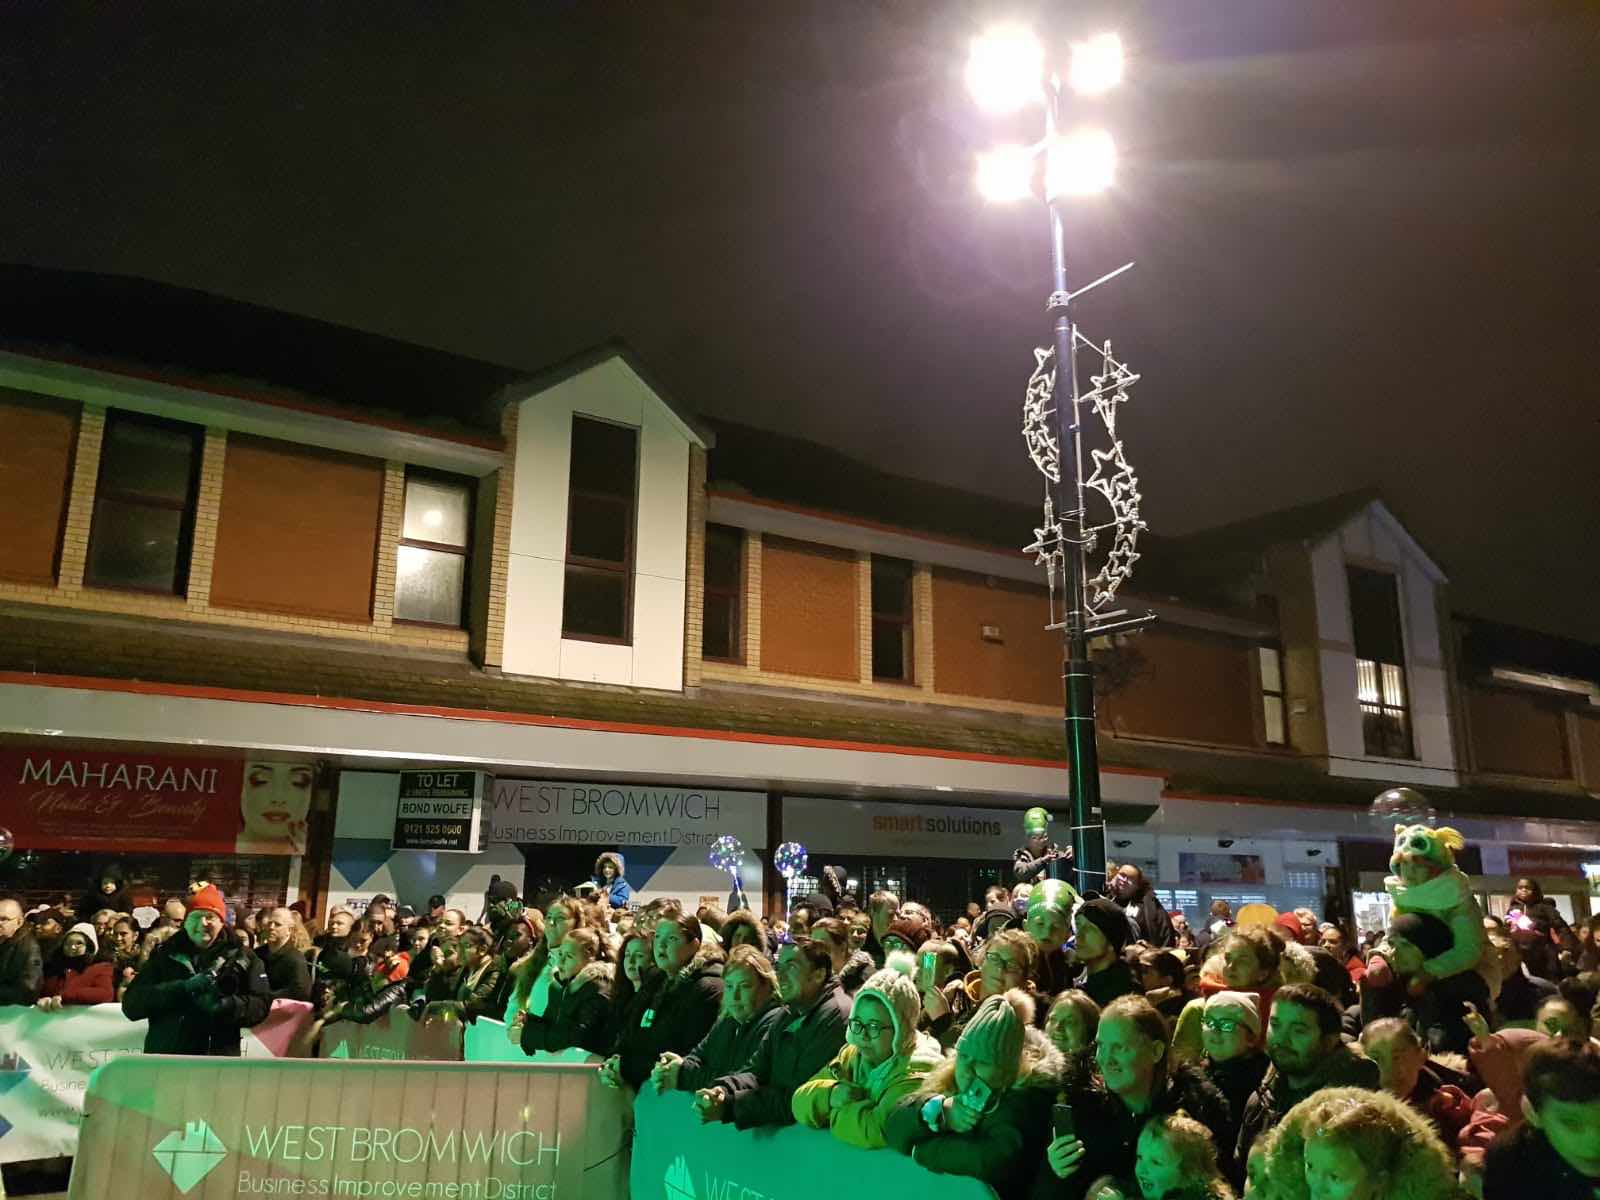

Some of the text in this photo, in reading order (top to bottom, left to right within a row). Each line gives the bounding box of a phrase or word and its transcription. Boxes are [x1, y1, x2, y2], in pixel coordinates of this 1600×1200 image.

[19, 758, 219, 793] MAHARANI
[416, 774, 460, 788] TO LET
[402, 803, 469, 815] BOND WOLFE
[492, 785, 720, 821] WEST BROMWICH
[494, 824, 556, 841] usiness
[558, 825, 671, 844] Improvement
[872, 815, 1001, 836] smart solutions
[246, 1125, 561, 1166] WEST BROMWICH
[238, 1170, 557, 1200] Business Improvement District
